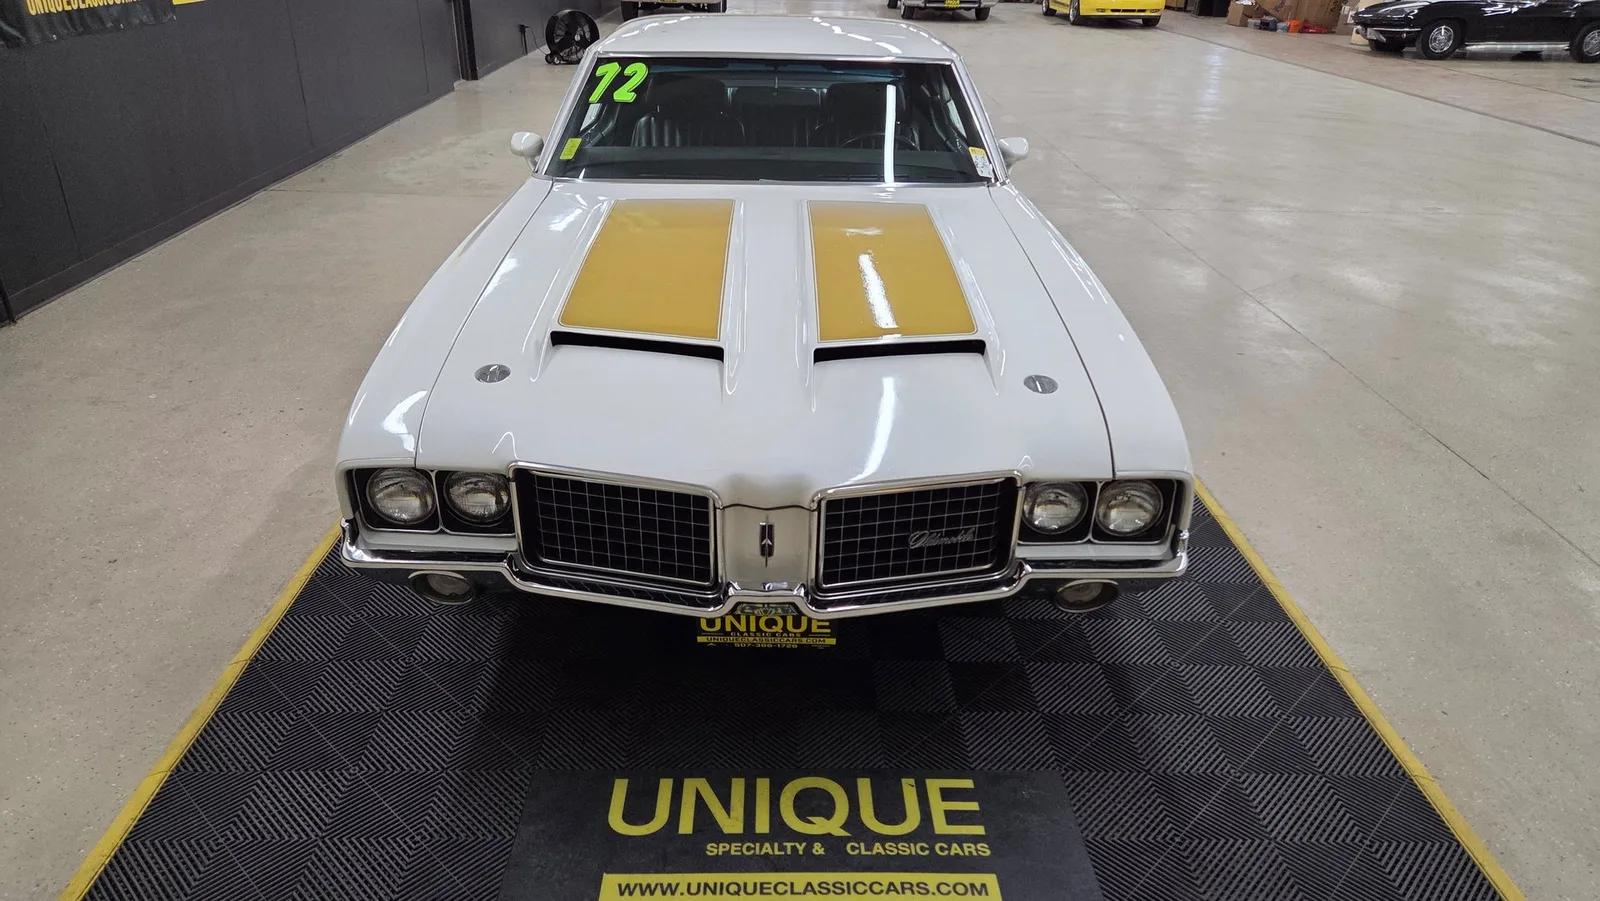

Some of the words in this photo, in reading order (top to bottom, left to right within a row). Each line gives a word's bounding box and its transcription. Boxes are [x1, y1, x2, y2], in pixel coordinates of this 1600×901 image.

[589, 62, 648, 103] 72
[700, 614, 831, 633] UNIQUE
[607, 777, 986, 837] UNIQUE
[705, 842, 806, 856] SPECIALTY
[812, 842, 826, 856] &
[846, 842, 930, 856] CLASSIC
[934, 843, 992, 857] CARS
[617, 881, 989, 897] WWW.UNIQUECLASSICCARS.COM
